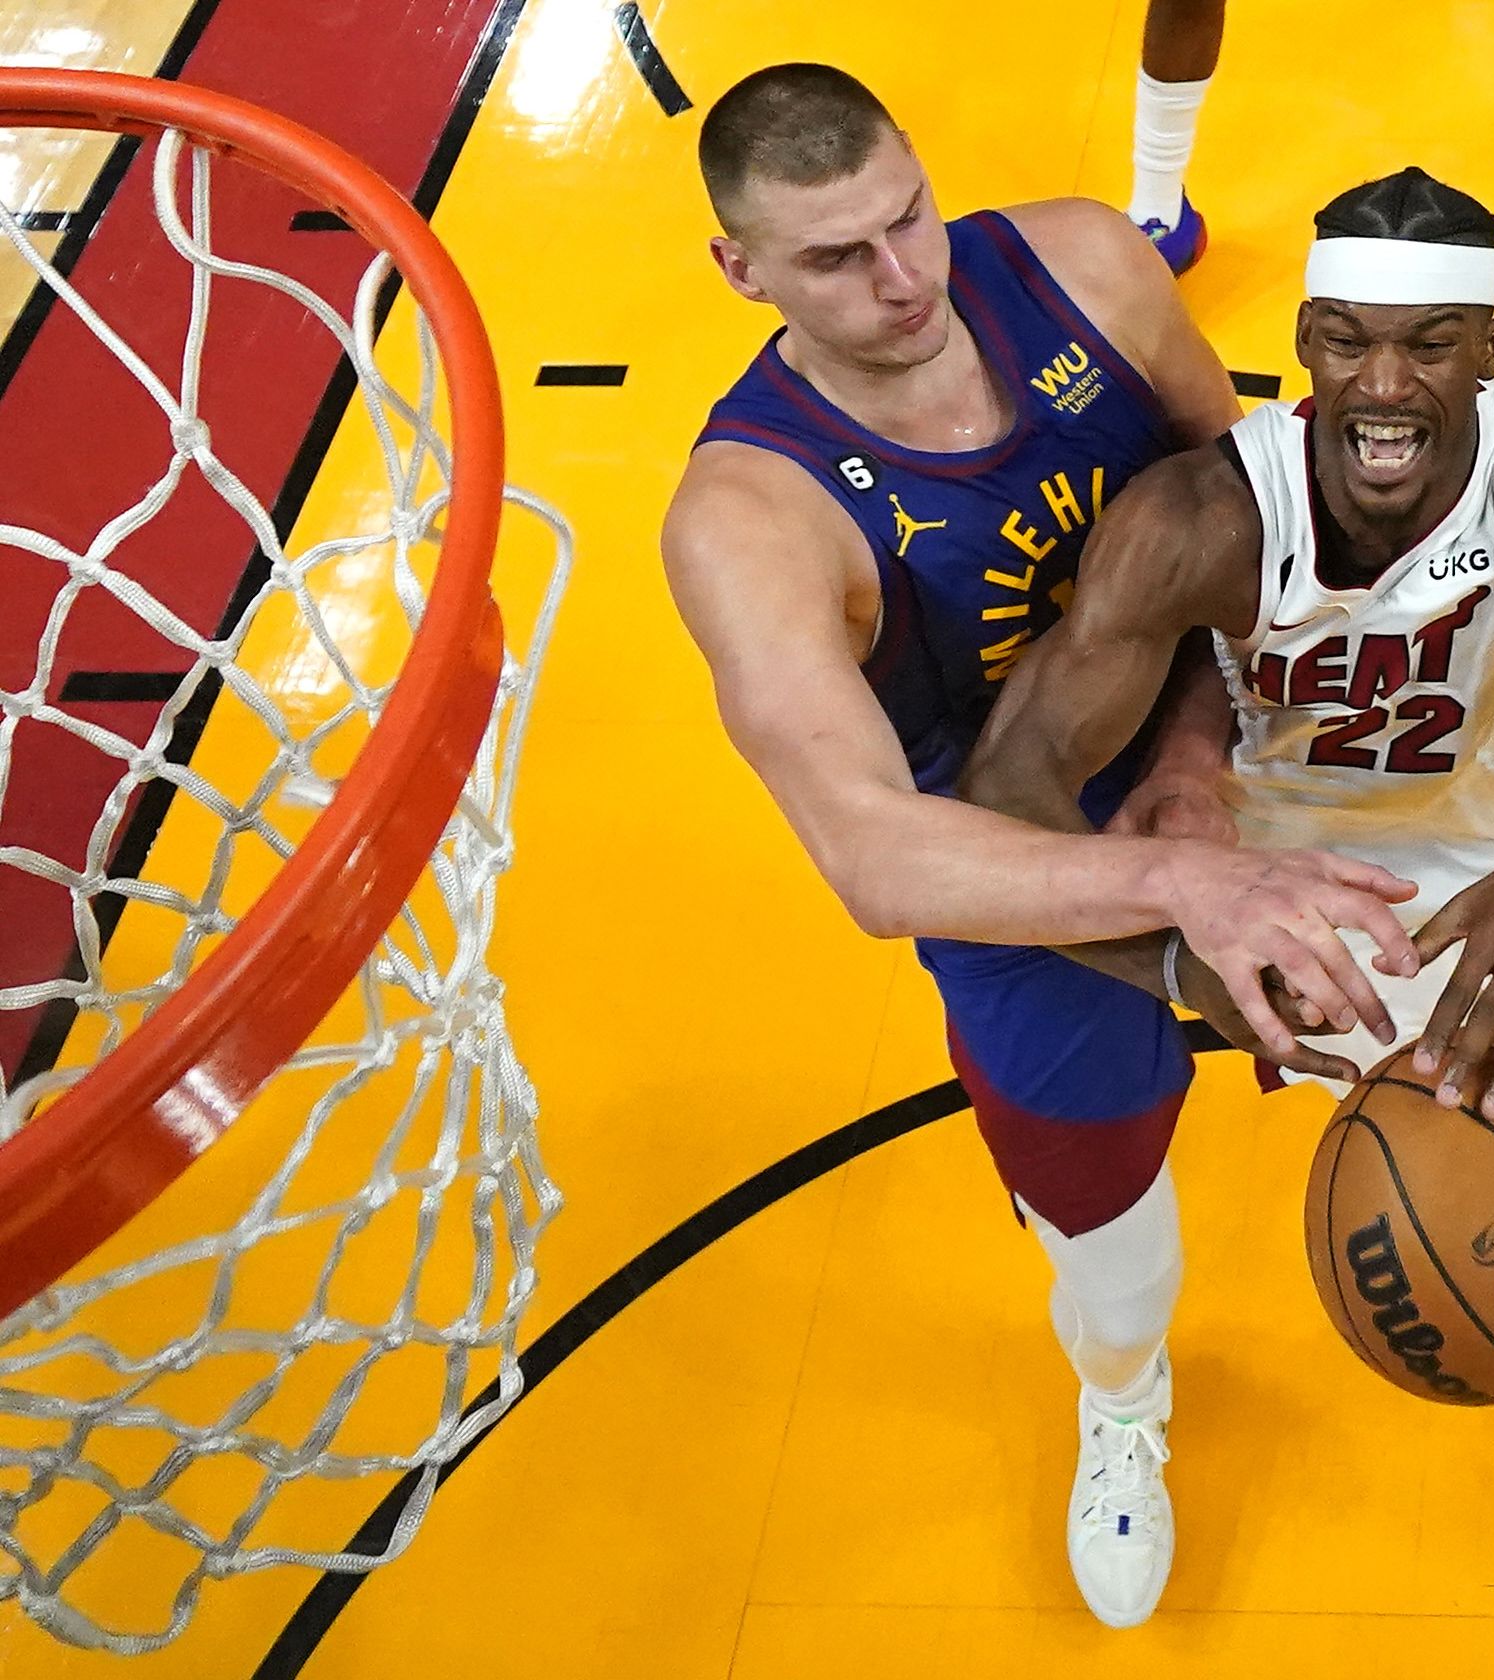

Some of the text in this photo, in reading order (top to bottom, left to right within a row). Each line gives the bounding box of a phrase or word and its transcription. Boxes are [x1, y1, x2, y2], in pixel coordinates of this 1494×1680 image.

[1030, 341, 1089, 397] WU
[1051, 367, 1103, 412] Western
[1068, 383, 1105, 415] Union
[839, 456, 875, 491] 6
[979, 508, 1058, 682] MILE
[1242, 584, 1491, 710] HEAT
[1306, 694, 1466, 774] 22
